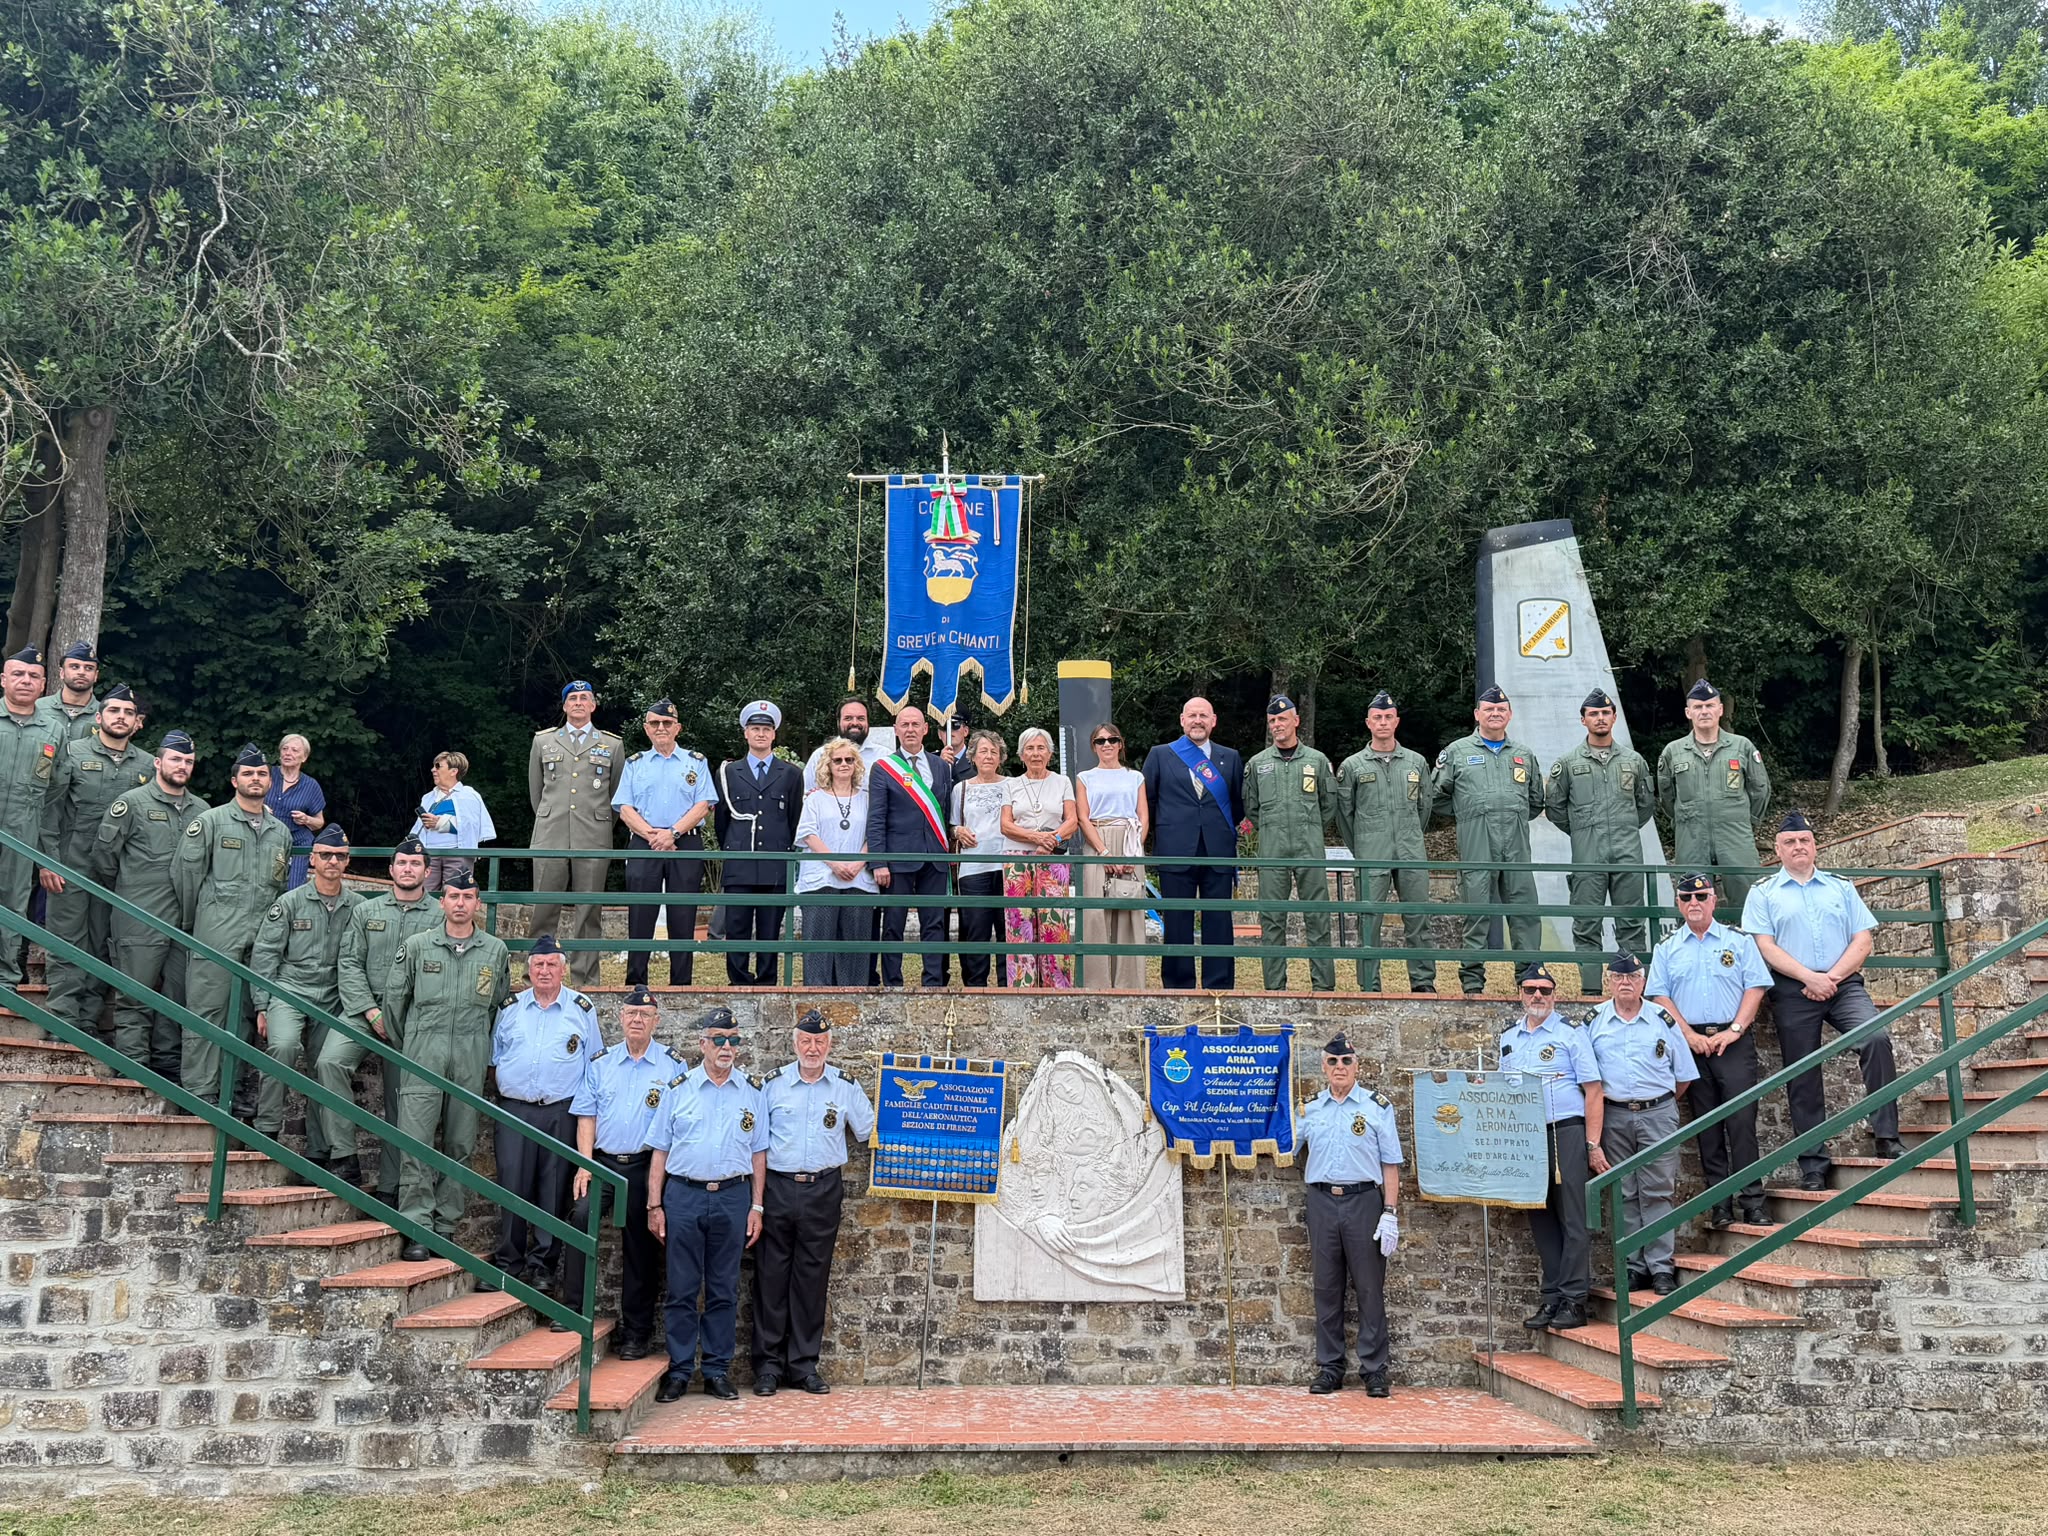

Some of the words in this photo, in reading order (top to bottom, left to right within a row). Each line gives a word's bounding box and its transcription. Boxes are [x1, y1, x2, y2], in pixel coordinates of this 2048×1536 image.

[941, 616, 950, 624] DI
[1531, 603, 1569, 644] AEROBRIGATA
[897, 632, 937, 649] GREVE
[949, 630, 999, 649] CHIANTI
[1202, 1045, 1279, 1054] ASSOCIAZIONE
[1226, 1056, 1256, 1064] ARMA
[1204, 1066, 1279, 1075] AERONAUTICA
[939, 1083, 994, 1095] ASSOCIAZIONE
[1206, 1088, 1239, 1096] SEZIONE
[1247, 1088, 1277, 1096] FIRENZE
[944, 1094, 988, 1104] NAZIONALE
[1459, 1091, 1539, 1105] ASSOCIAZIONE
[885, 1100, 921, 1109] FAMIGLIE
[922, 1103, 953, 1112] CADUTI
[953, 1104, 959, 1112] E
[959, 1105, 997, 1114] MUTILATI
[1200, 1101, 1245, 1116] Guglielmo
[902, 1111, 978, 1123] DELL'AERONAUTICA
[1476, 1107, 1517, 1121] ARMA
[902, 1120, 935, 1130] SEZIONE
[936, 1123, 945, 1131] DI
[946, 1123, 977, 1133] FIRENZE
[1476, 1121, 1540, 1133] AERONAUTICA
[1493, 1138, 1502, 1146] DI
[1503, 1138, 1530, 1147] PRATO
[1510, 1153, 1521, 1161] AL
